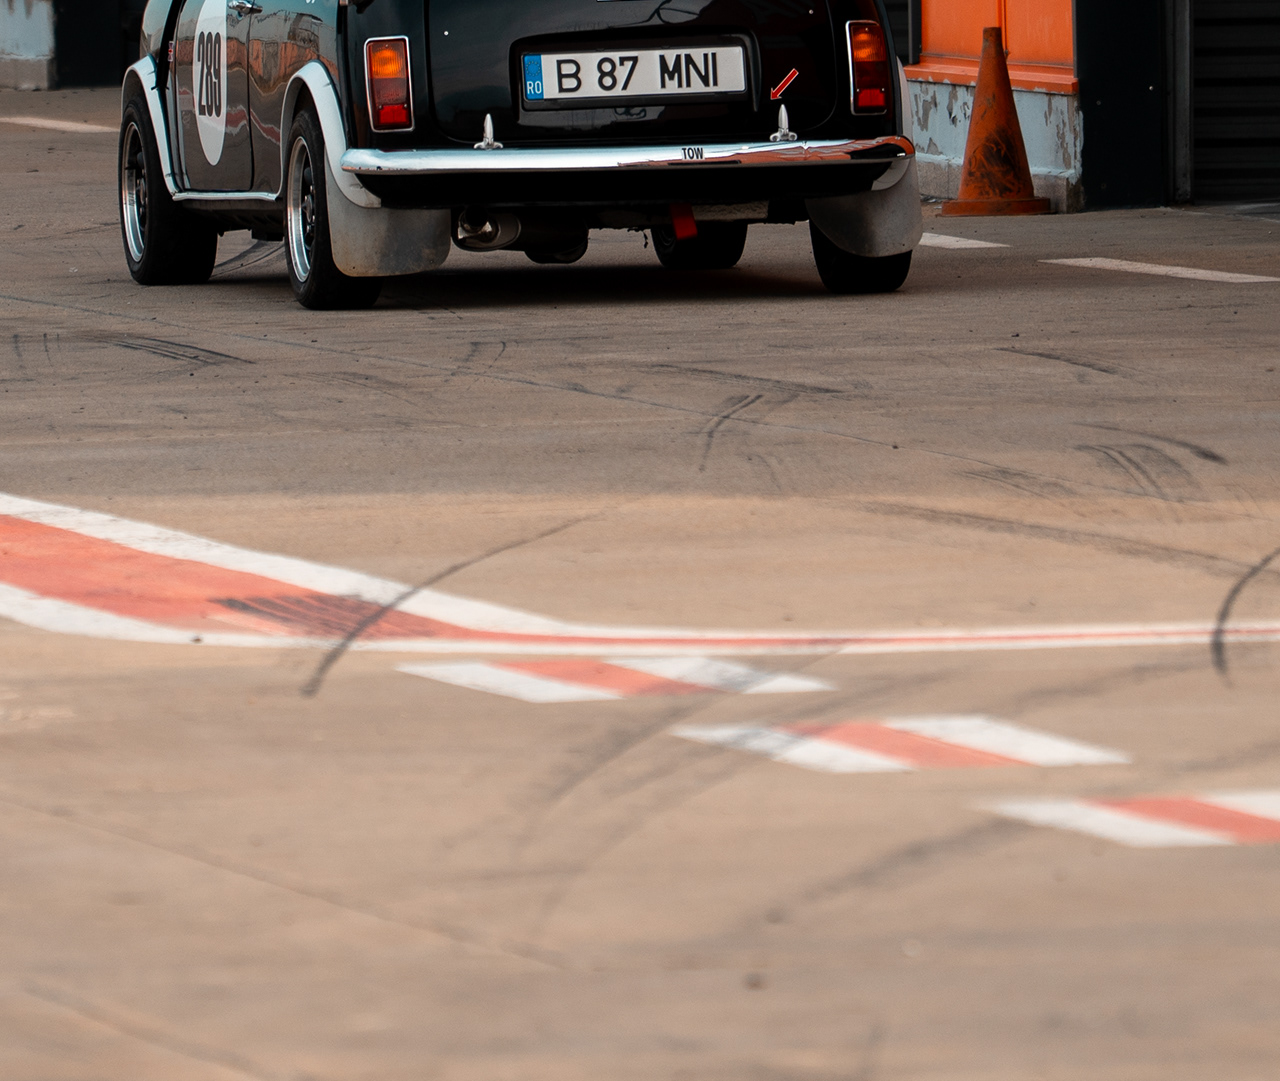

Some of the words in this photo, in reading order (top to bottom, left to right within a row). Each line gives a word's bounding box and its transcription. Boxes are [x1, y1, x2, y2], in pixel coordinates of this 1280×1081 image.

[197, 31, 222, 118] 289
[556, 58, 582, 94] B
[597, 55, 639, 92] 87
[659, 52, 718, 89] MNI
[526, 80, 542, 95] RO
[681, 147, 704, 160] TOW
